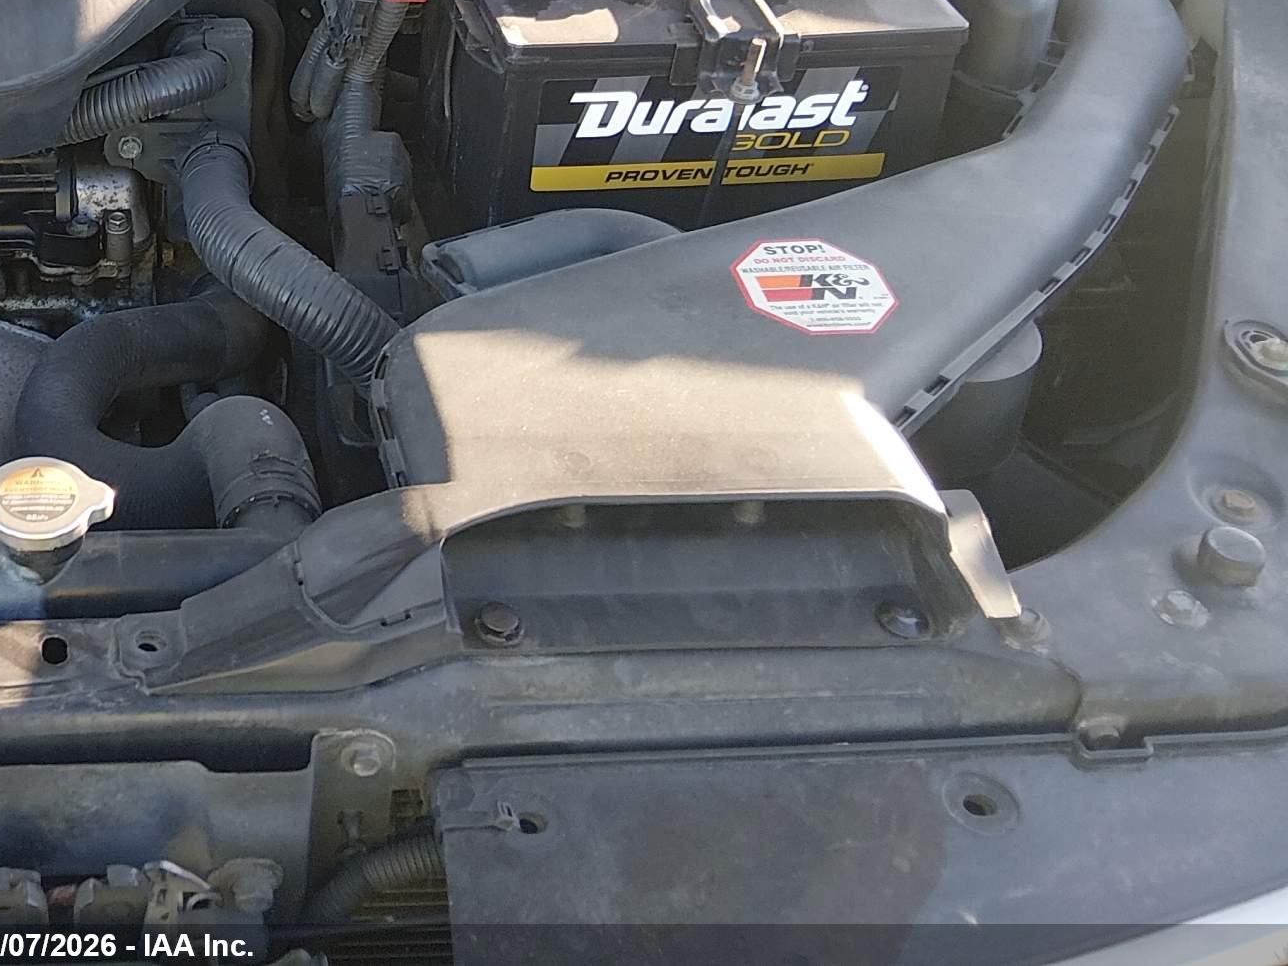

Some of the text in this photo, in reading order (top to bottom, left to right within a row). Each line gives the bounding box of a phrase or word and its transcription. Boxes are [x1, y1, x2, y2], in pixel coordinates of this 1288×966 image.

[732, 130, 850, 151] GOLD
[605, 163, 810, 183] PROVEN TOUGH
[763, 244, 826, 255] STOP!
[771, 256, 795, 264] NOT
[799, 255, 846, 263] DISCARD
